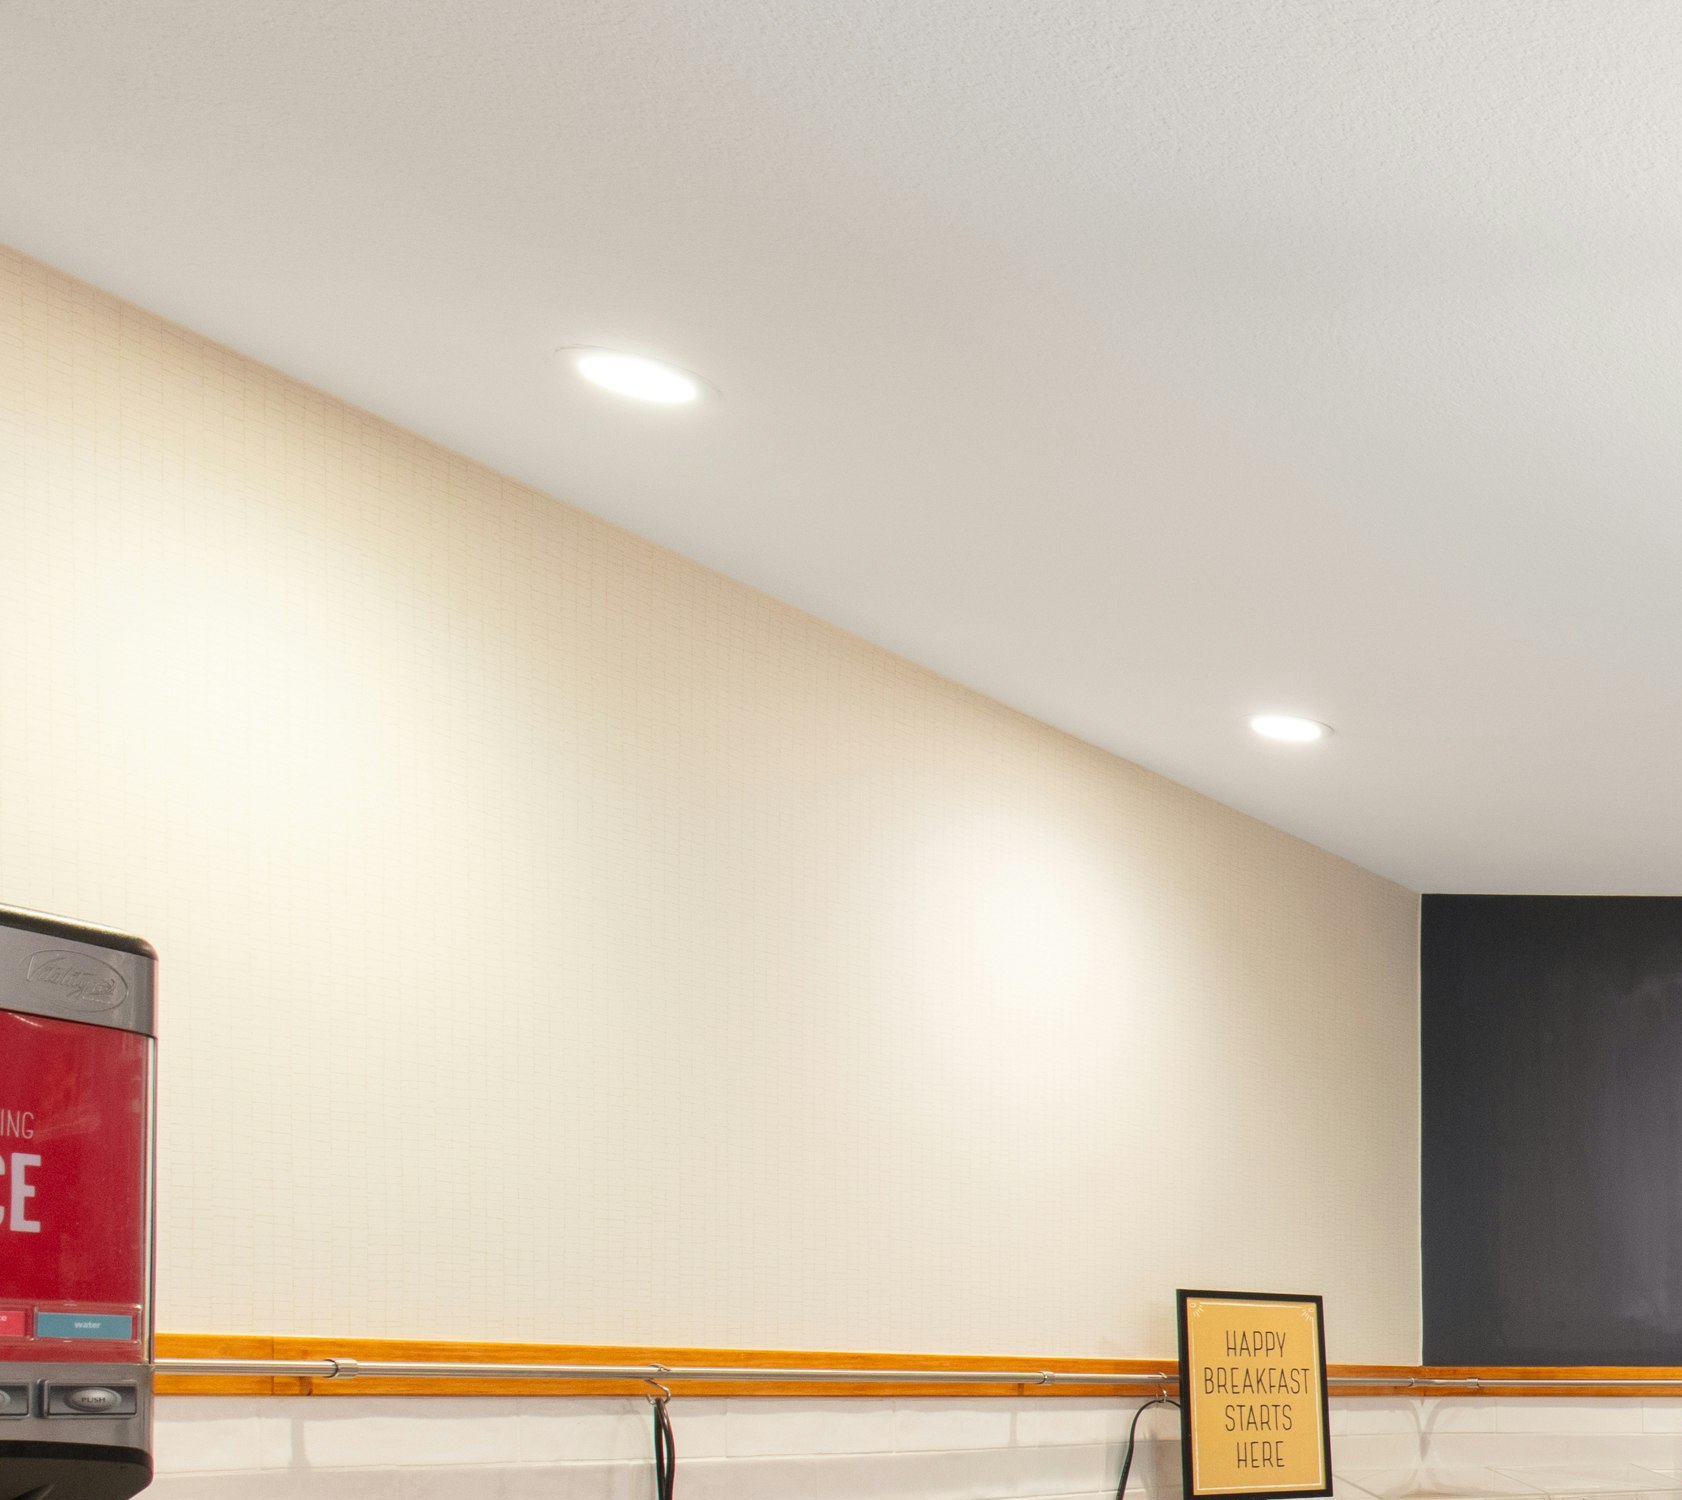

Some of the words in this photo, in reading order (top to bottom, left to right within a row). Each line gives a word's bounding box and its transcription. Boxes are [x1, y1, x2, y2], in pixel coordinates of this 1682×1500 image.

[0, 1152, 42, 1234] E
[74, 1320, 102, 1329] water
[1226, 1330, 1286, 1358] HAPPY
[1204, 1366, 1310, 1395] BREAKFAST
[1225, 1404, 1293, 1432] STARTS
[1237, 1440, 1286, 1468] HERE
